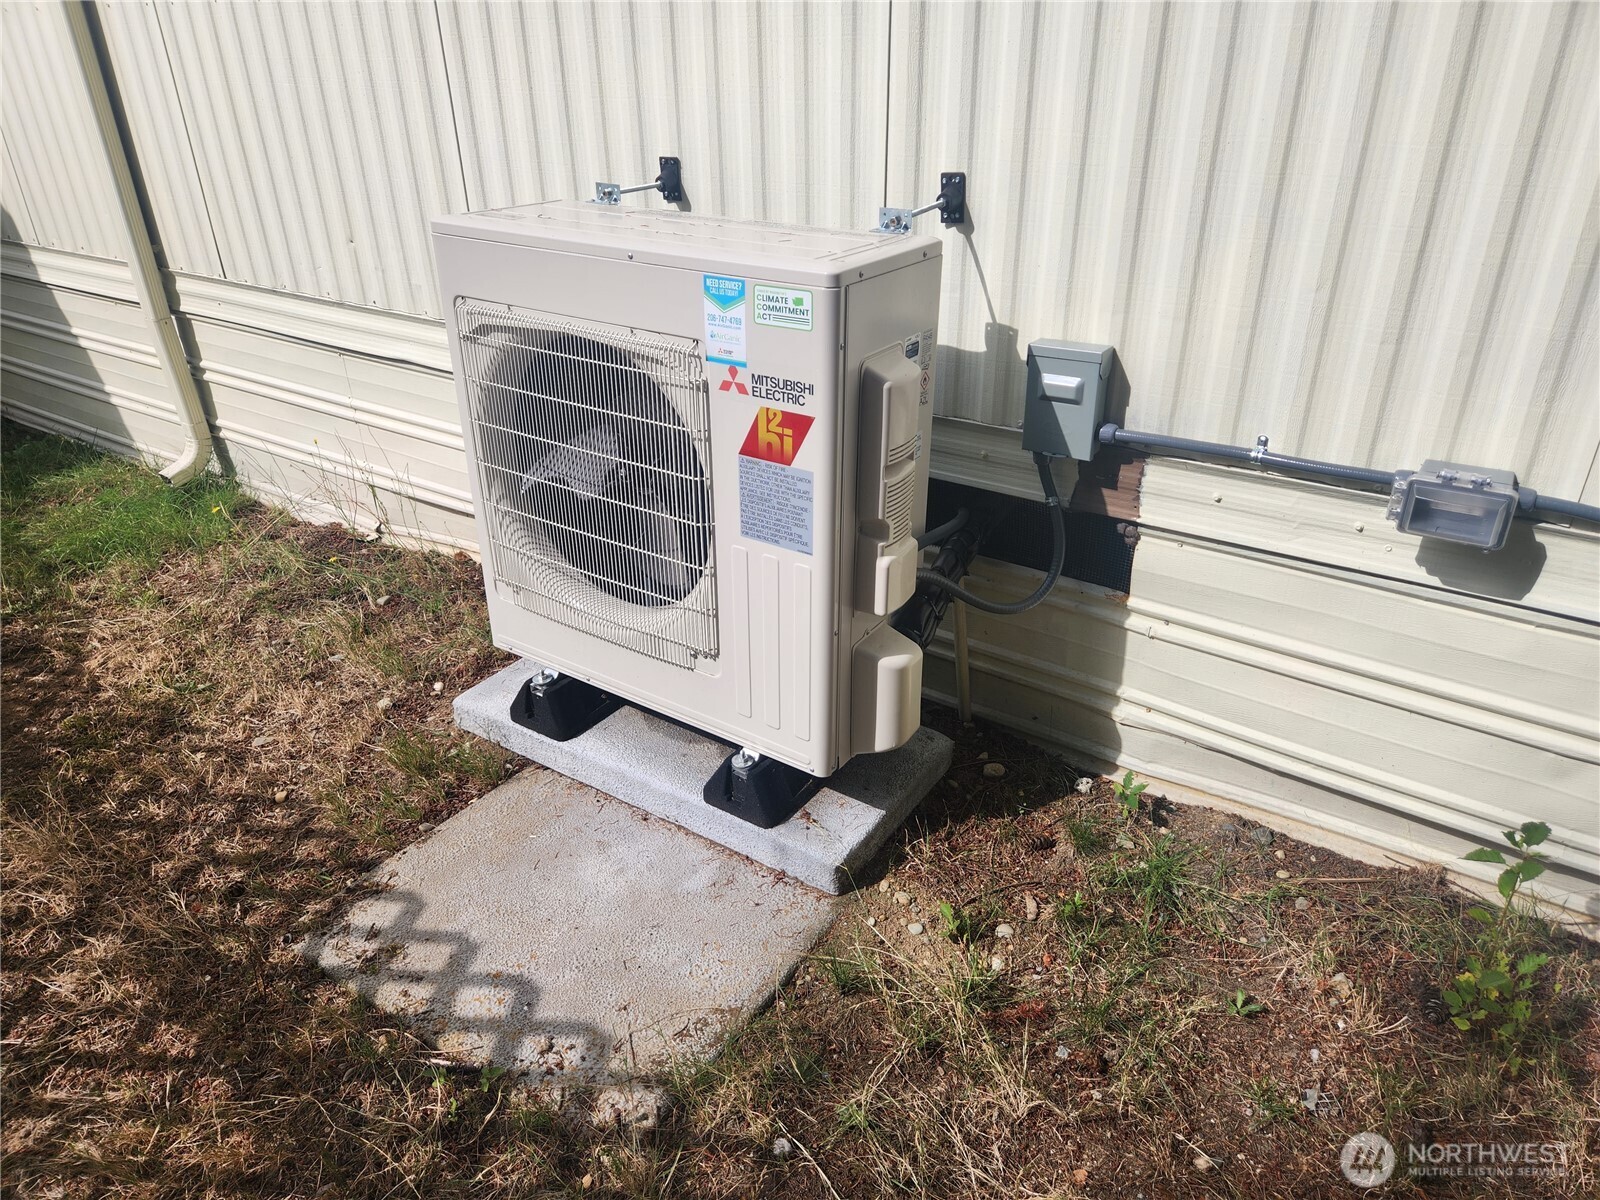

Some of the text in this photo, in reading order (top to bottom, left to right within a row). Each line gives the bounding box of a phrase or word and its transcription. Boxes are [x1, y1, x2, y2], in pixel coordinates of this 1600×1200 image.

[706, 278, 742, 291] NEED SERVICE?
[710, 286, 719, 294] CALL
[725, 289, 739, 297] TODAY!
[756, 294, 788, 305] CLIMATE
[756, 303, 810, 316] COMMITMENT
[756, 312, 772, 321] ACT
[752, 373, 814, 396] MITSUBISHI
[752, 386, 805, 406] ELECTRIC
